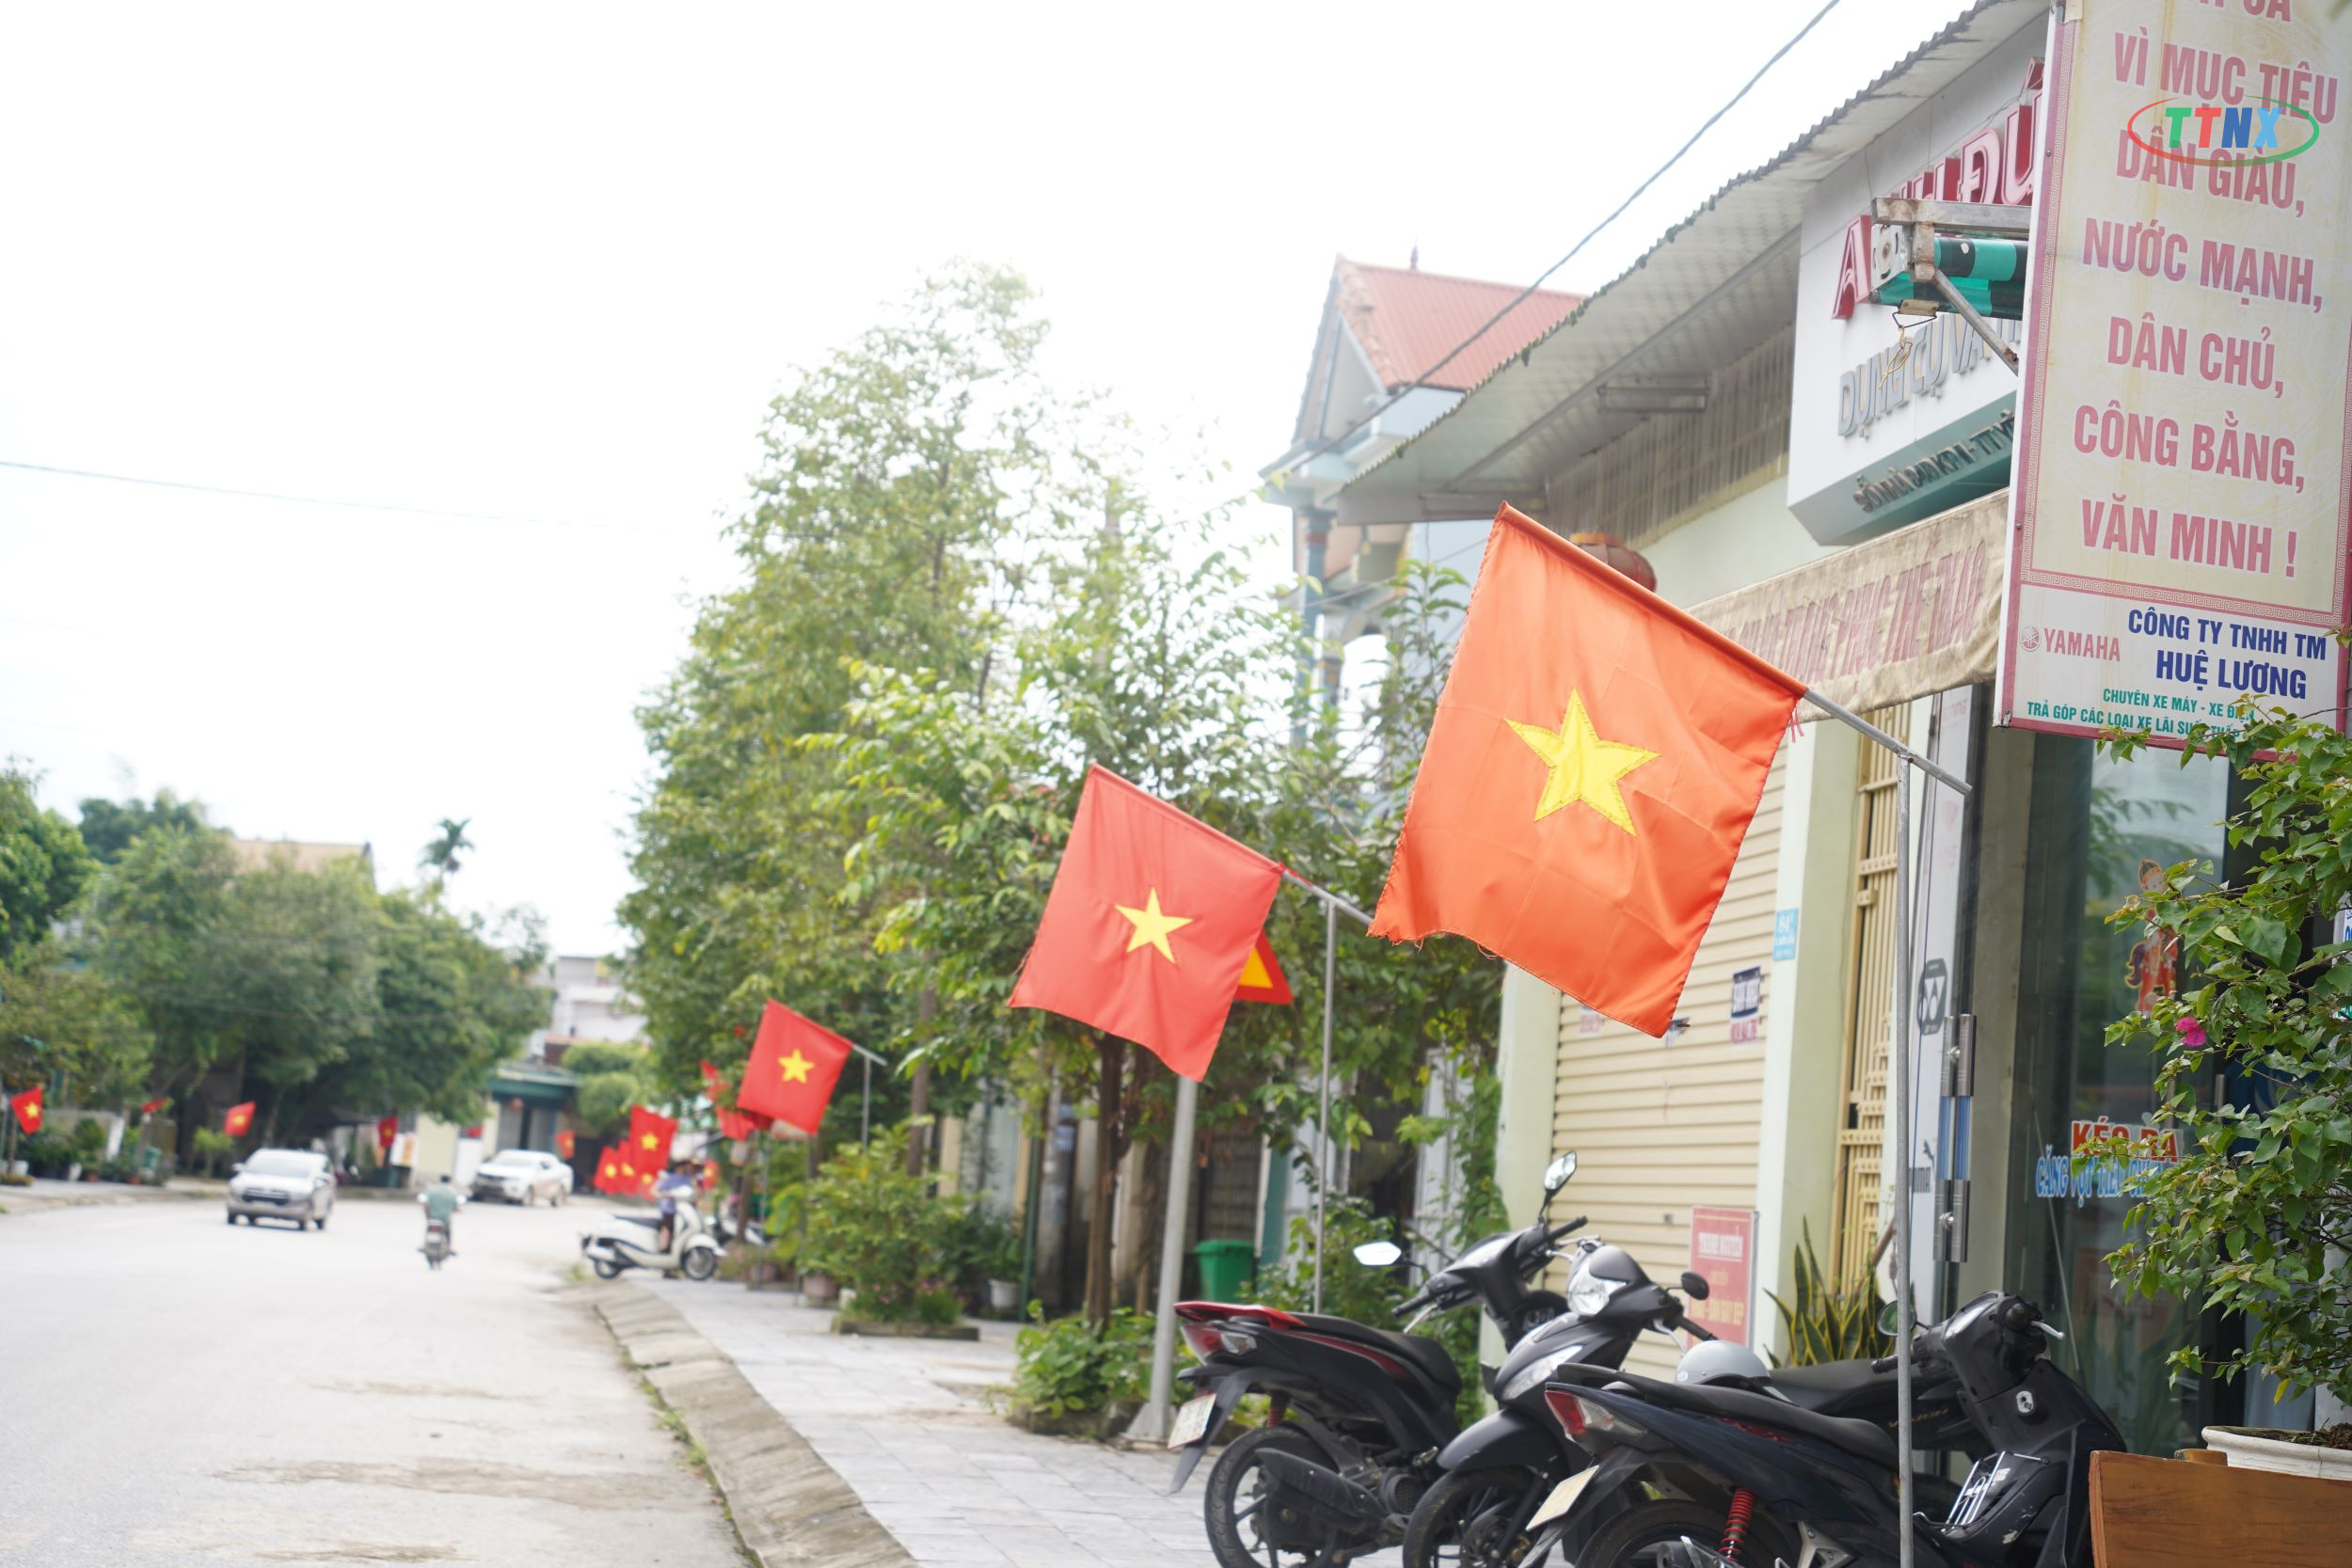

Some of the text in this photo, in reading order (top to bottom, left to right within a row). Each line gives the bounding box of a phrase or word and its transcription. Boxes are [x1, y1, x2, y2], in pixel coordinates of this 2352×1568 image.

[2114, 27, 2339, 124] VÌ MỤC TIÊU
[2117, 124, 2305, 217] DÂN GIÀU,
[2082, 217, 2322, 313] NƯỚC MẠNH,
[2107, 311, 2284, 398] DÂN CHỦ,
[2074, 399, 2304, 494] CÔNG BẰNG,
[2082, 493, 2297, 578] VĂN MINH !
[2043, 627, 2121, 662] YAMAHA
[2128, 607, 2327, 660] CÔNG TY TNHH TM
[2155, 649, 2307, 700] HUỆ LƯƠNG
[2027, 699, 2049, 718] TRẢ
[2053, 704, 2077, 721] GÓP
[2080, 707, 2104, 724] CÁC
[2107, 713, 2134, 731] LOẠI
[2137, 716, 2152, 730] XE
[2155, 716, 2173, 734] LÃI
[2103, 689, 2149, 706] CHUYÊN
[2153, 694, 2168, 709] XE
[2171, 696, 2198, 713] MÁY
[2209, 702, 2223, 717] XE
